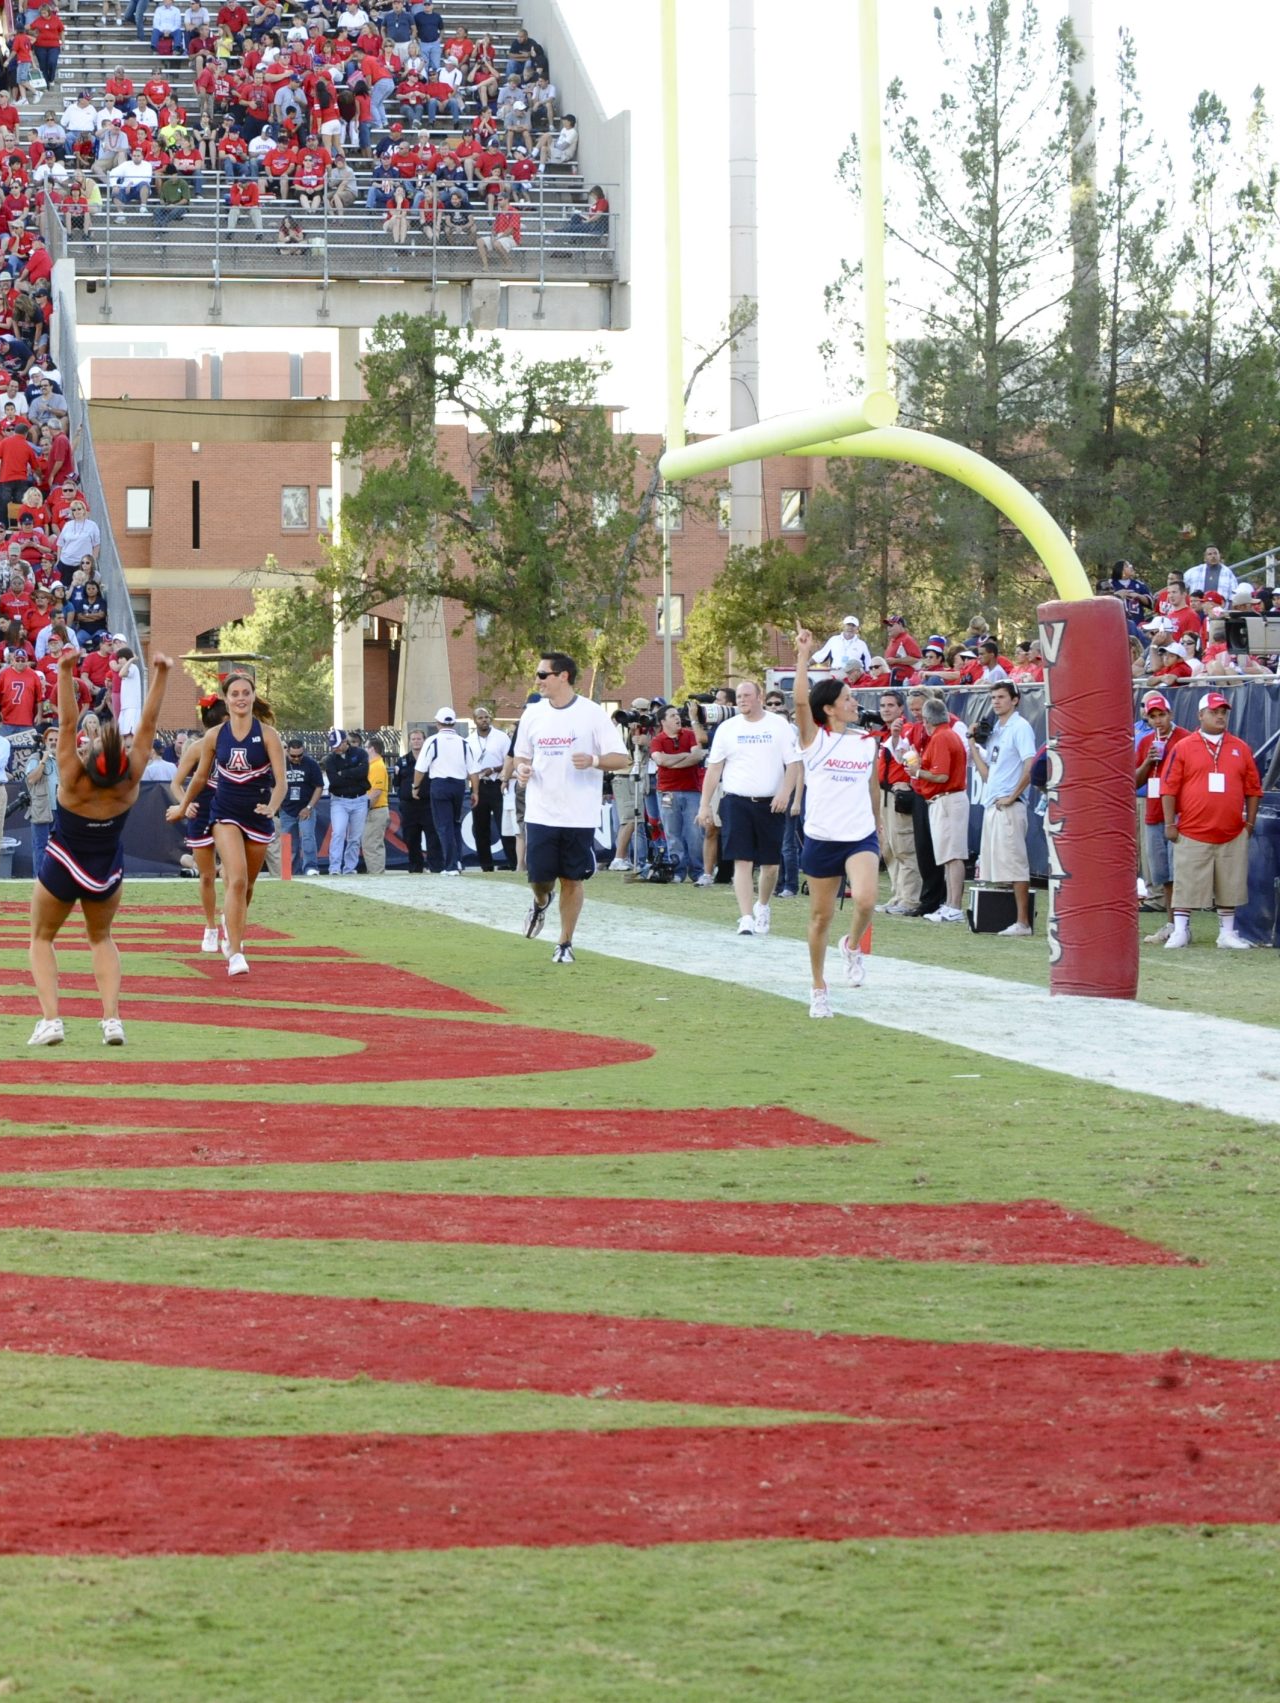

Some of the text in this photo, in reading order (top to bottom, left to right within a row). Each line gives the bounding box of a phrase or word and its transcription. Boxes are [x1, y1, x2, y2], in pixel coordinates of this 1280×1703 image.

[12, 681, 25, 705] 7
[537, 736, 572, 746] ARIZONA
[226, 748, 252, 772] A
[823, 758, 869, 770] ARIZONA
